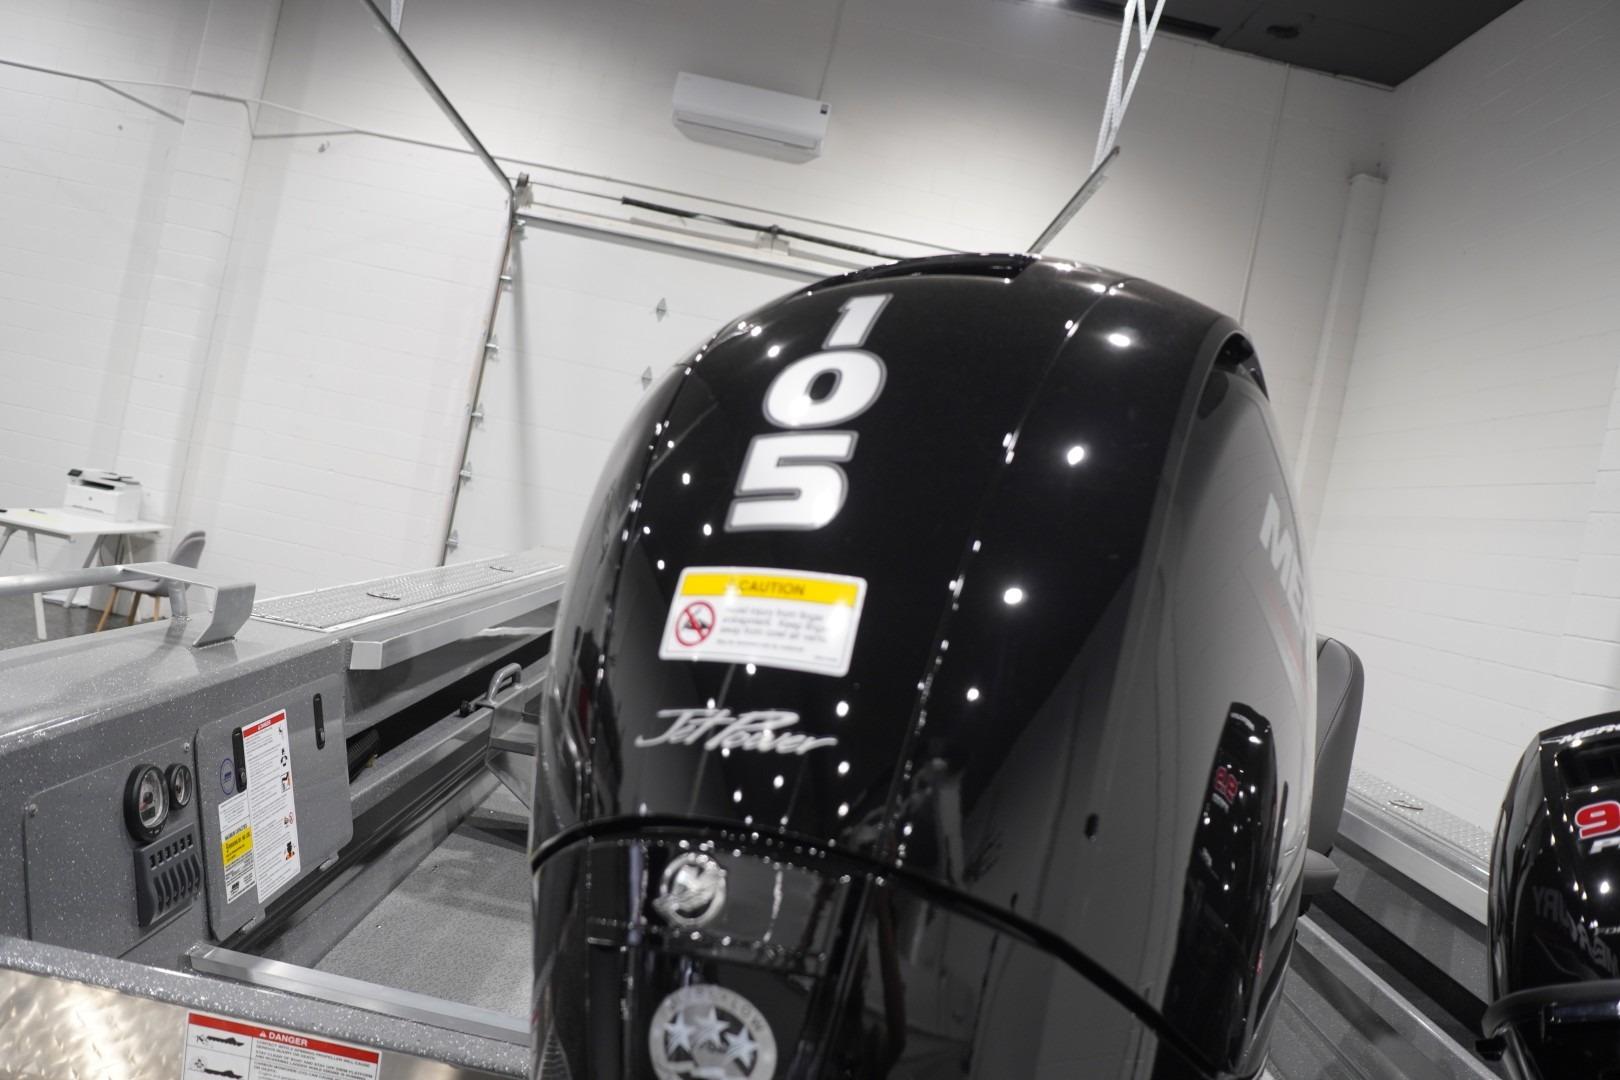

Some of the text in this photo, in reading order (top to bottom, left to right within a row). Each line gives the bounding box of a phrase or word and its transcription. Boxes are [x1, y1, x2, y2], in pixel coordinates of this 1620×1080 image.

[722, 292, 894, 533] 105
[740, 579, 805, 596] CAUTION
[268, 1032, 308, 1047] DANGER
